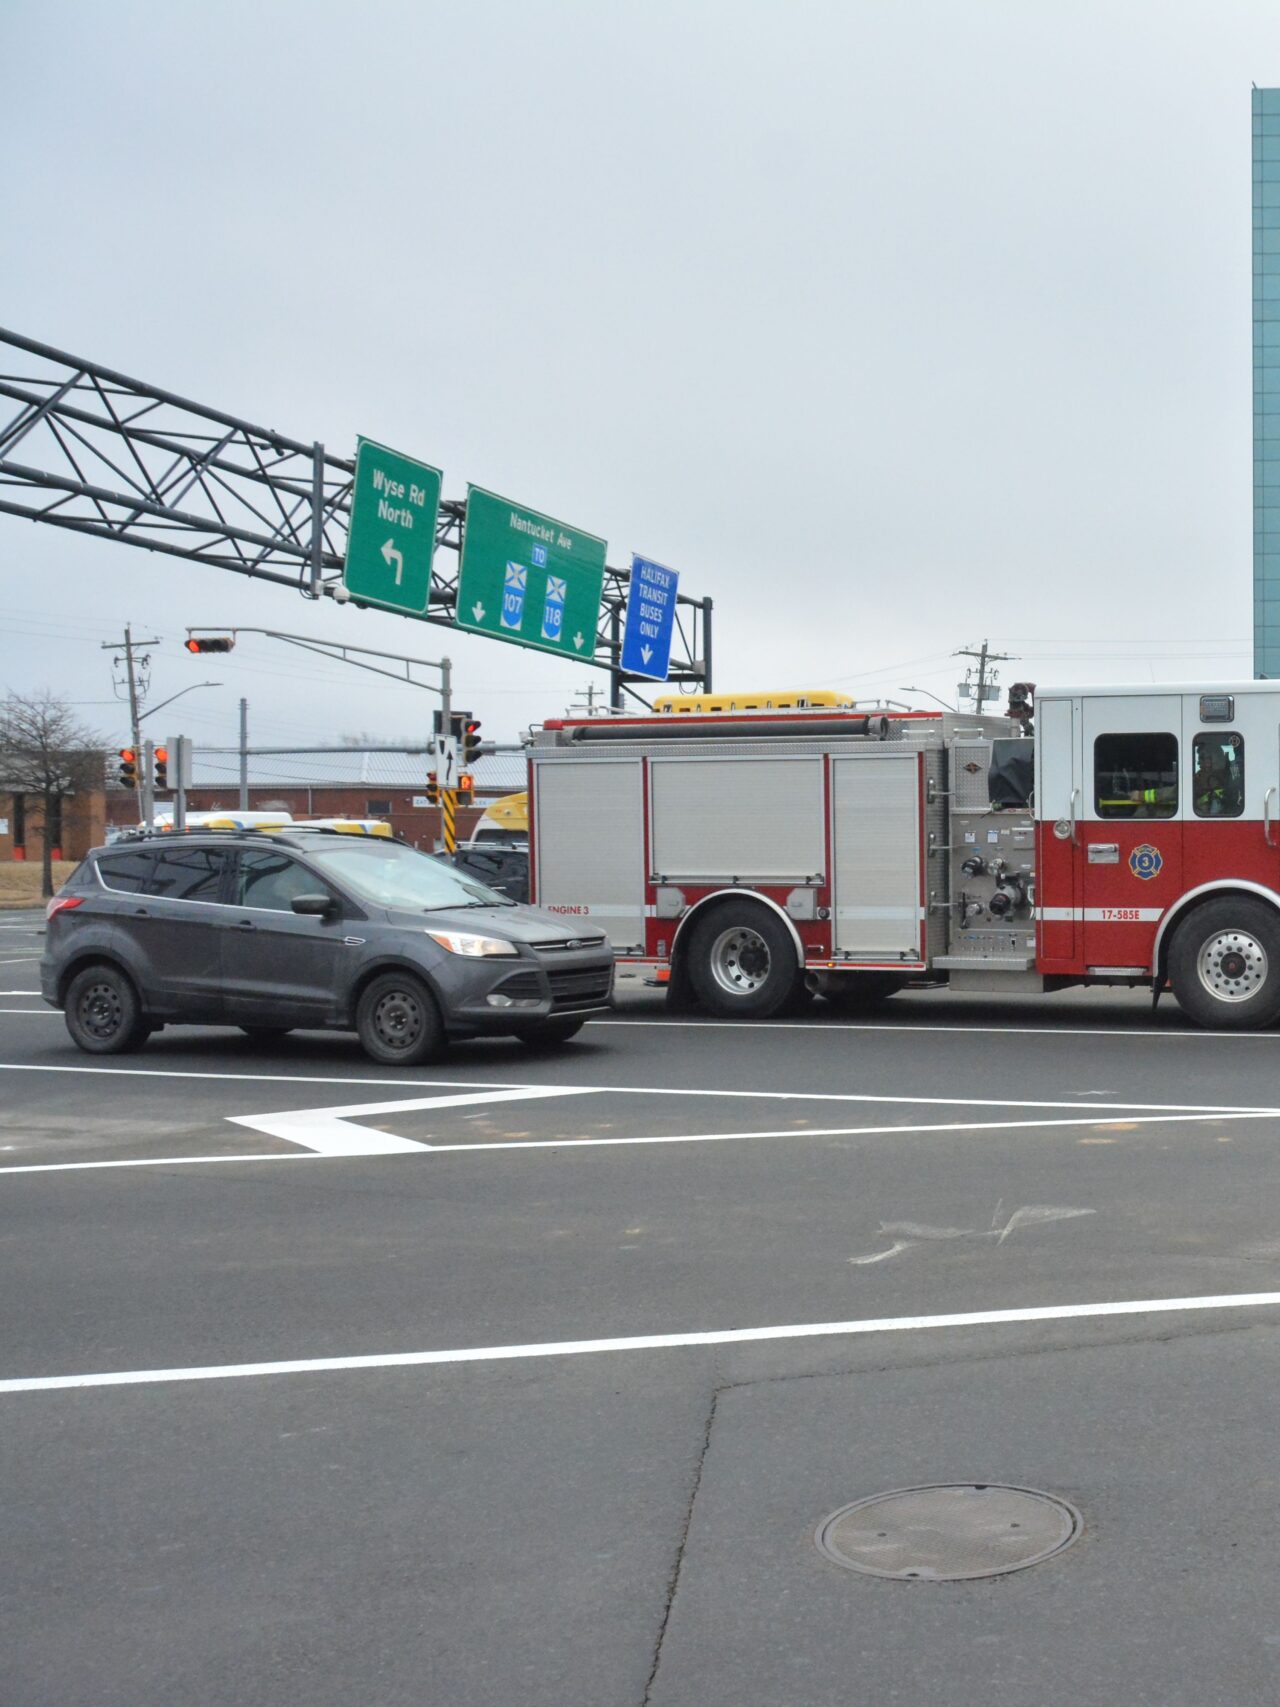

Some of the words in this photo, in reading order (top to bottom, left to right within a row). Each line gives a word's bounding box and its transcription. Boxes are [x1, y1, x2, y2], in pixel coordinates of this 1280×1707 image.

[373, 469, 405, 498] Wyse
[409, 484, 425, 507] Rd
[378, 499, 413, 528] North
[510, 512, 554, 543] Nantucket
[557, 532, 572, 550] Ave
[535, 547, 545, 563] TO
[641, 566, 671, 589] HALIFAX
[504, 593, 522, 614] 107
[639, 583, 668, 606] TRANSIT
[545, 606, 561, 627] 118
[640, 603, 663, 623] BUSES
[640, 621, 659, 639] ONLY
[1142, 857, 1149, 867] 3
[547, 906, 582, 915] ENGINE
[583, 906, 589, 915] 3
[1102, 910, 1140, 920] 17-585E
